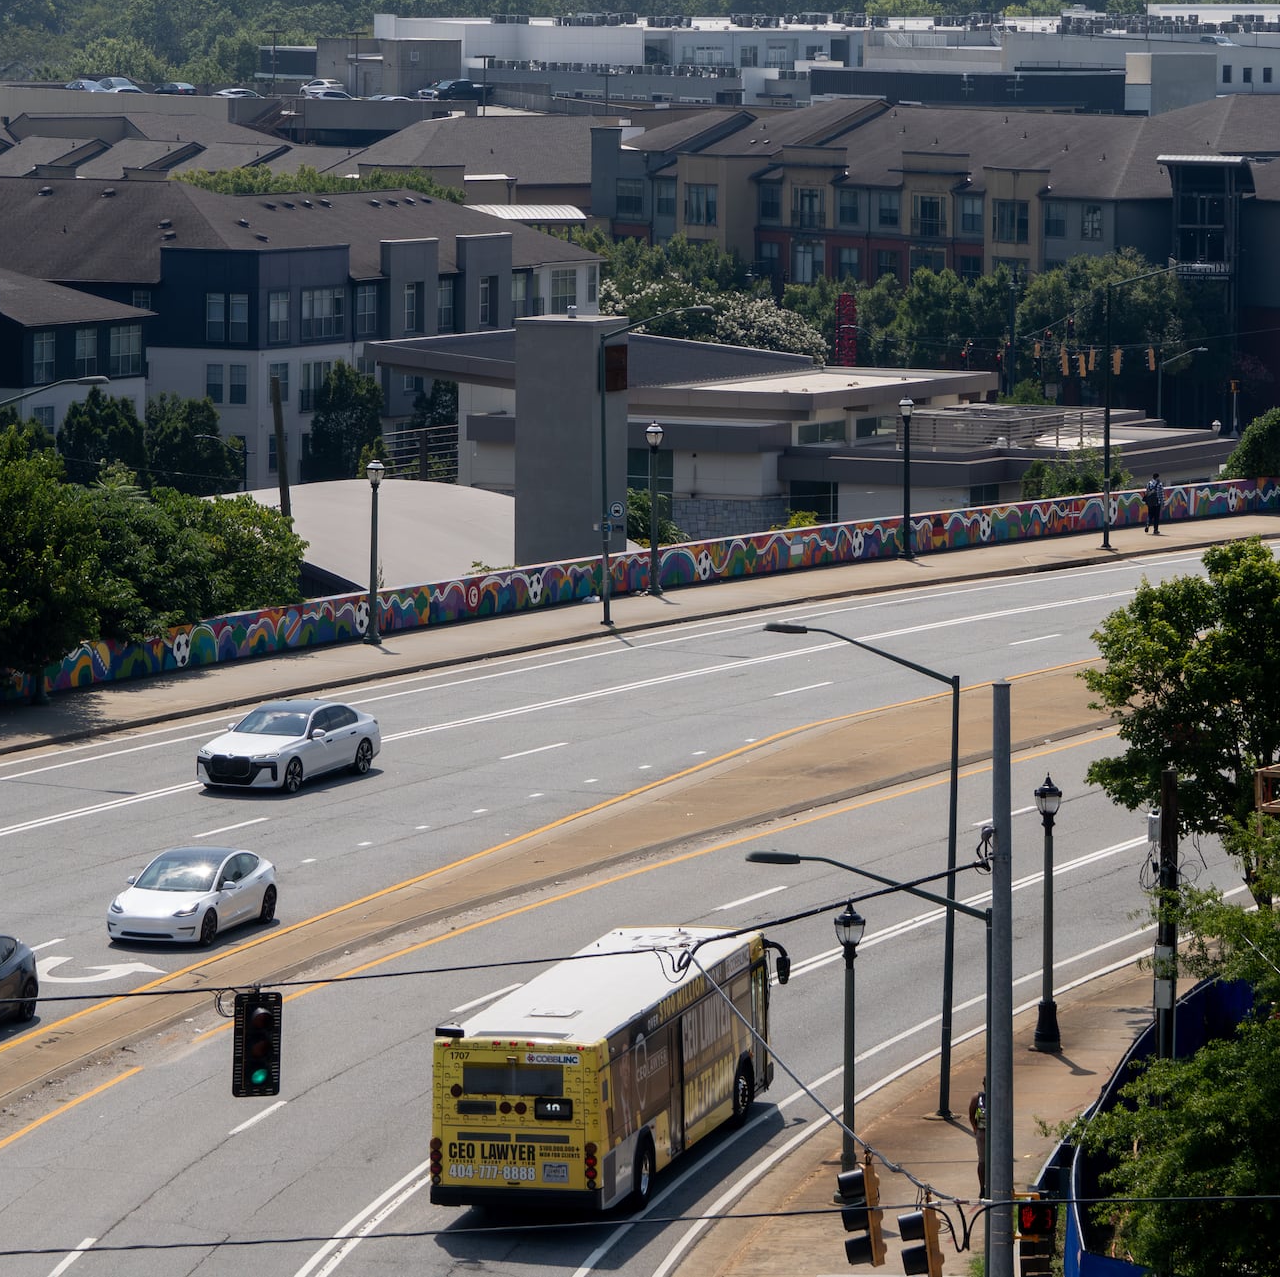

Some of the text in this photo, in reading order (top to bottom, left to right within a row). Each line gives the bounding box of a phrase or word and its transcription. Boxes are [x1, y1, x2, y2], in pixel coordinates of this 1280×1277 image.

[450, 1051, 471, 1061] 1707
[535, 1054, 578, 1065] COBBLINC
[448, 1142, 536, 1162] CEO LAWYER
[449, 1164, 537, 1181] 404-777-8888
